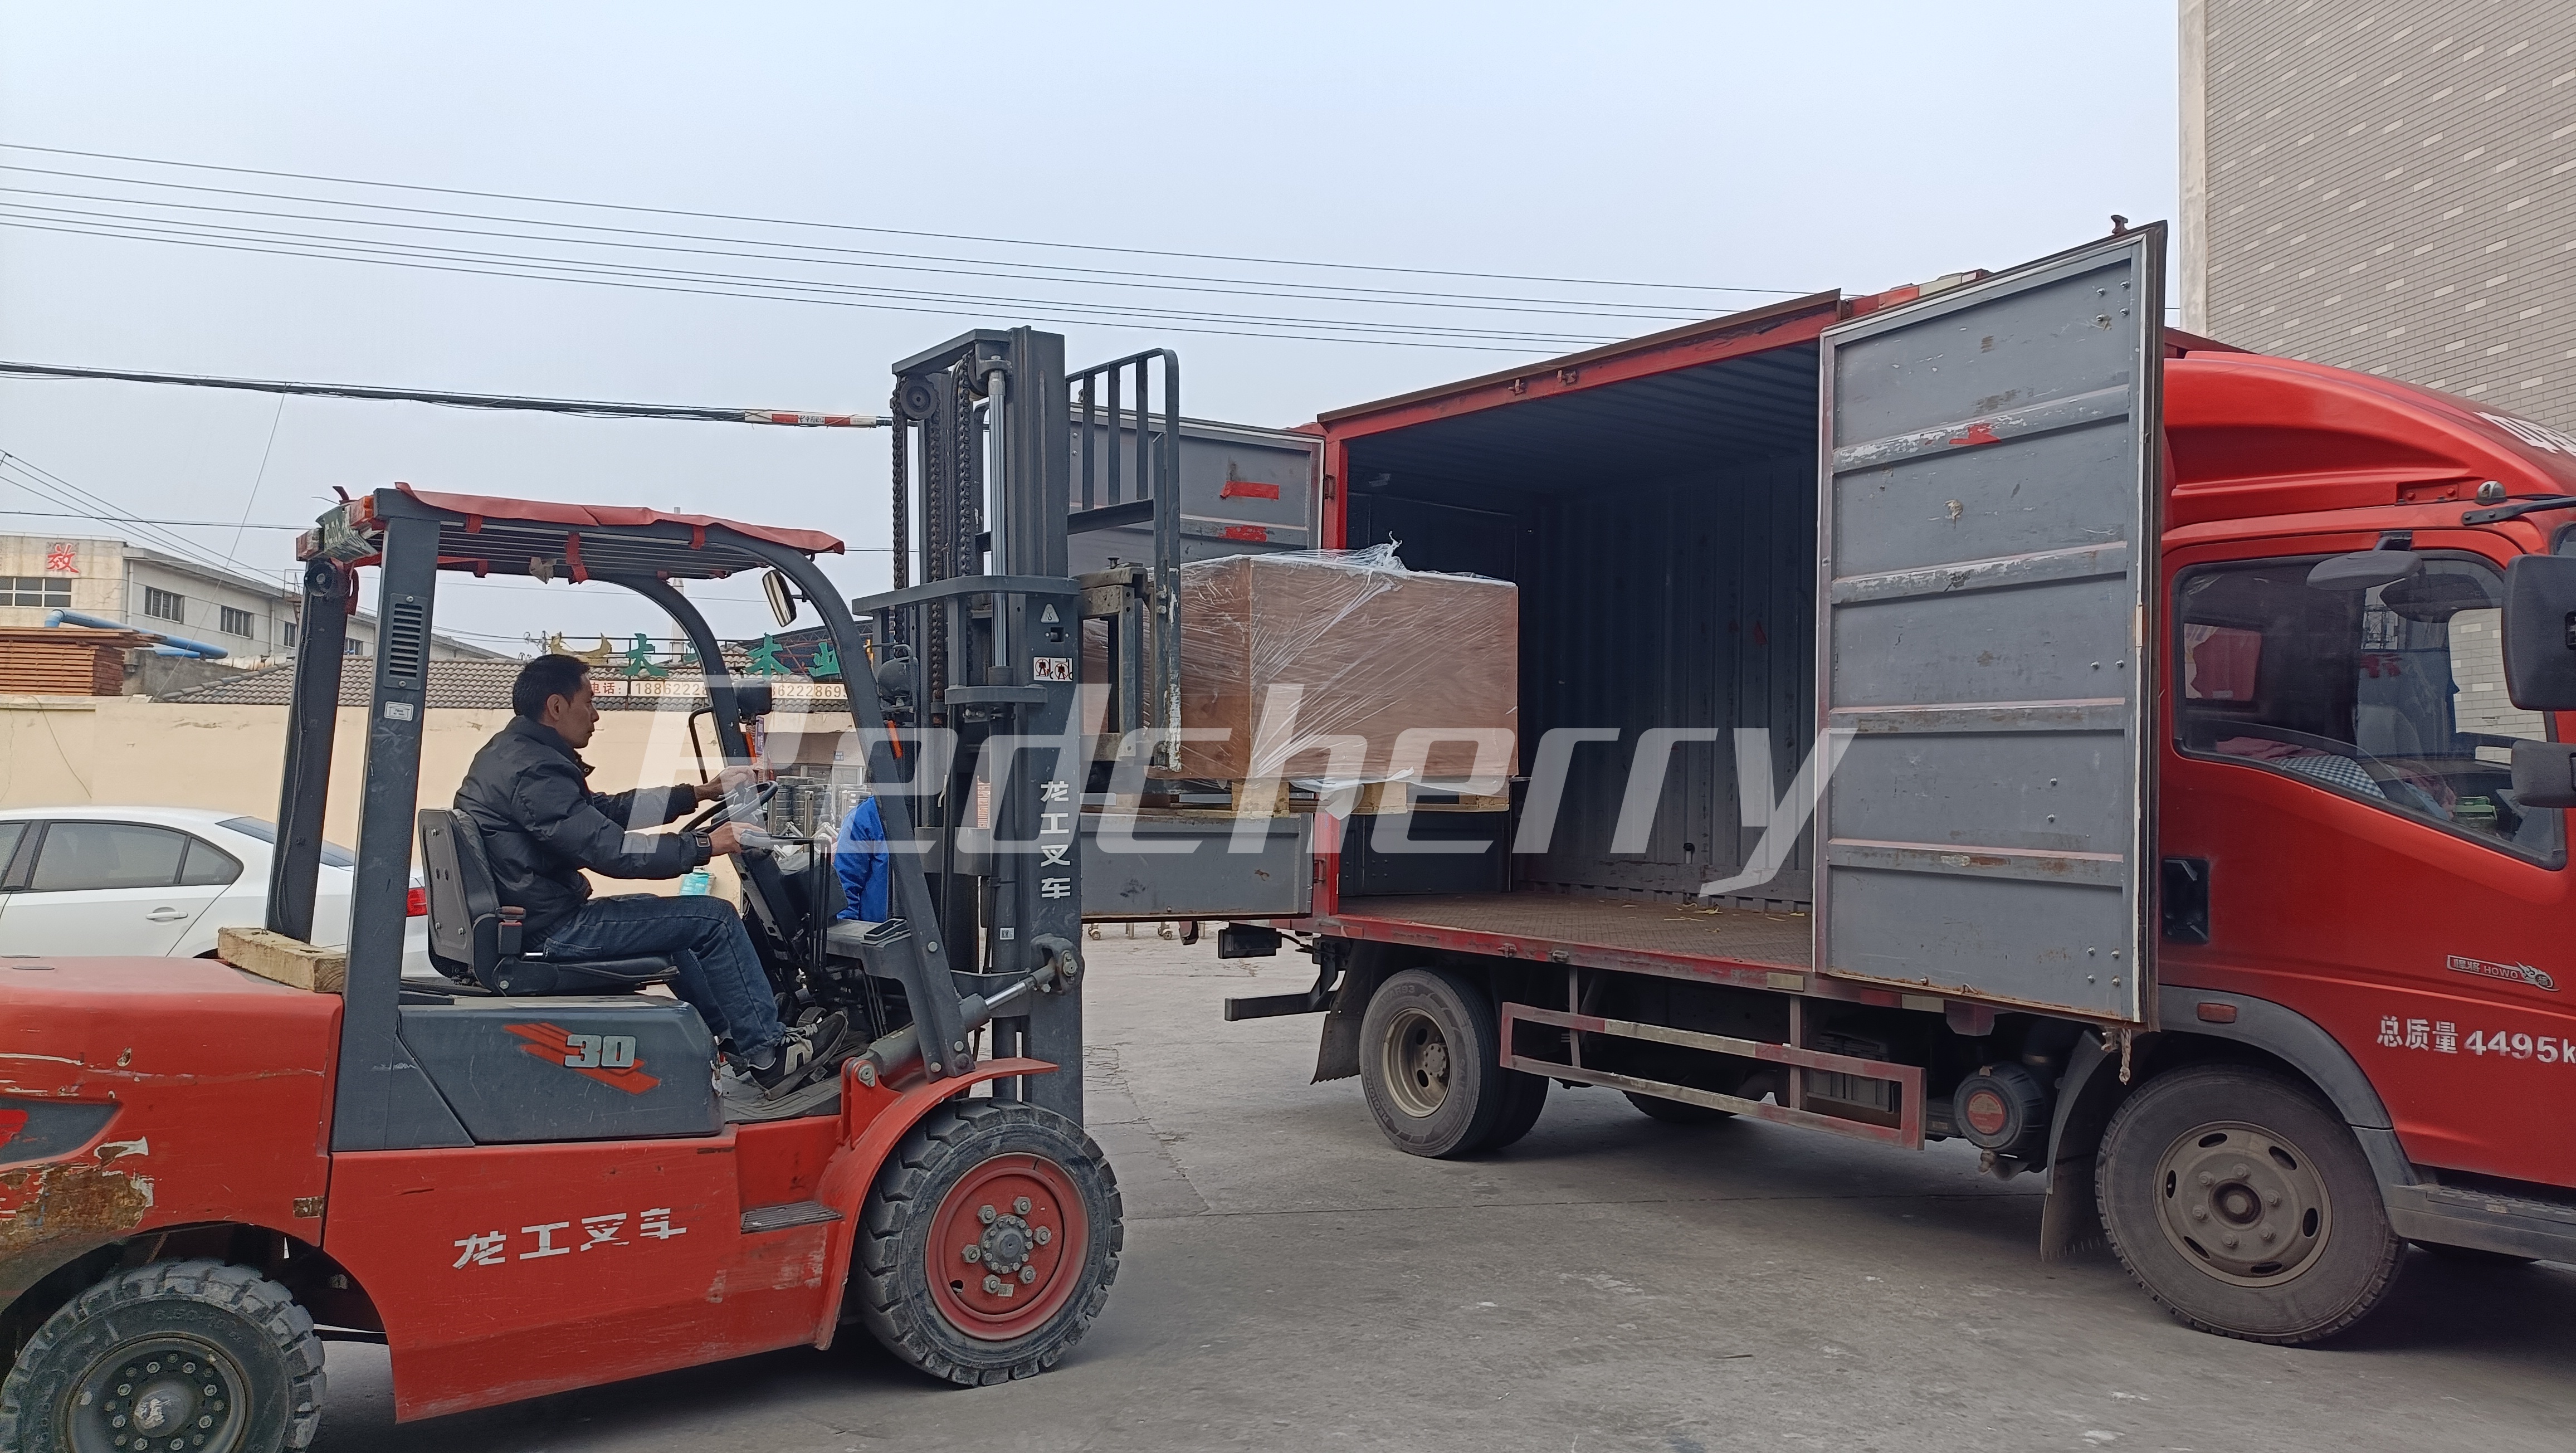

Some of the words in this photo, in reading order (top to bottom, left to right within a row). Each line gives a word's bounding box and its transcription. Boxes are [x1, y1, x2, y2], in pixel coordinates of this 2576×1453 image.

[2472, 412, 2576, 457] 中国
[46, 544, 80, 573] 效
[1041, 781, 1071, 899] 龙工叉车
[2484, 966, 2518, 979] HOWO
[564, 1034, 636, 1068] 30
[452, 1207, 687, 1270] 龙工叉车
